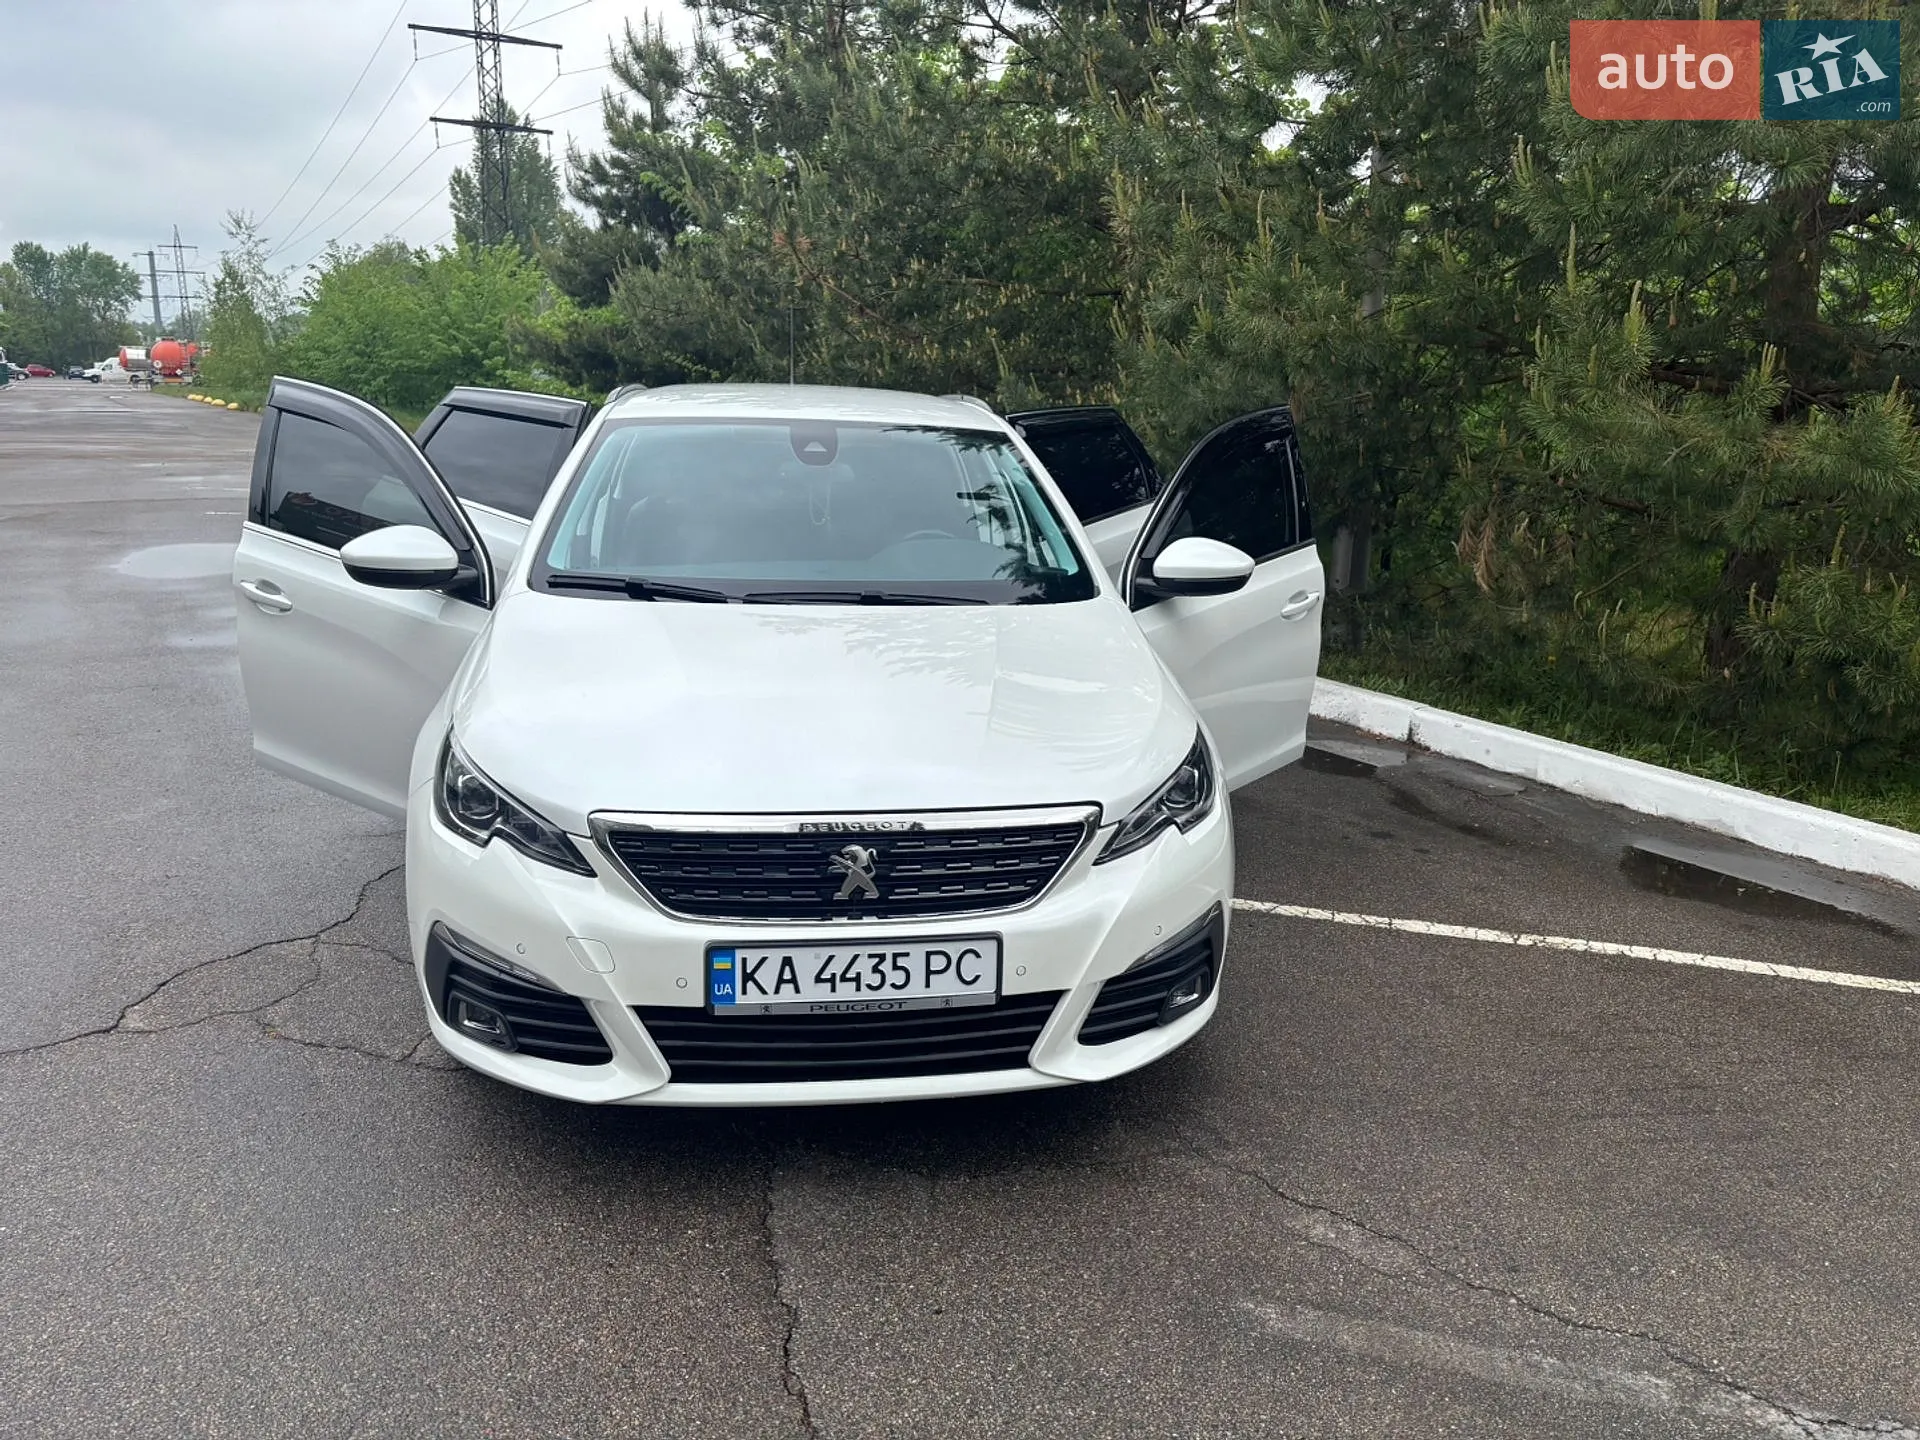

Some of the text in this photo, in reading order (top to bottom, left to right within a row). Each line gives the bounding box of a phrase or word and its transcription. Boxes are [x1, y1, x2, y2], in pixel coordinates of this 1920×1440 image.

[800, 821, 907, 832] PEUGEOT
[741, 948, 983, 995] KA 4435 PC
[714, 983, 733, 996] UA
[810, 1001, 908, 1012] PEUGEOT
